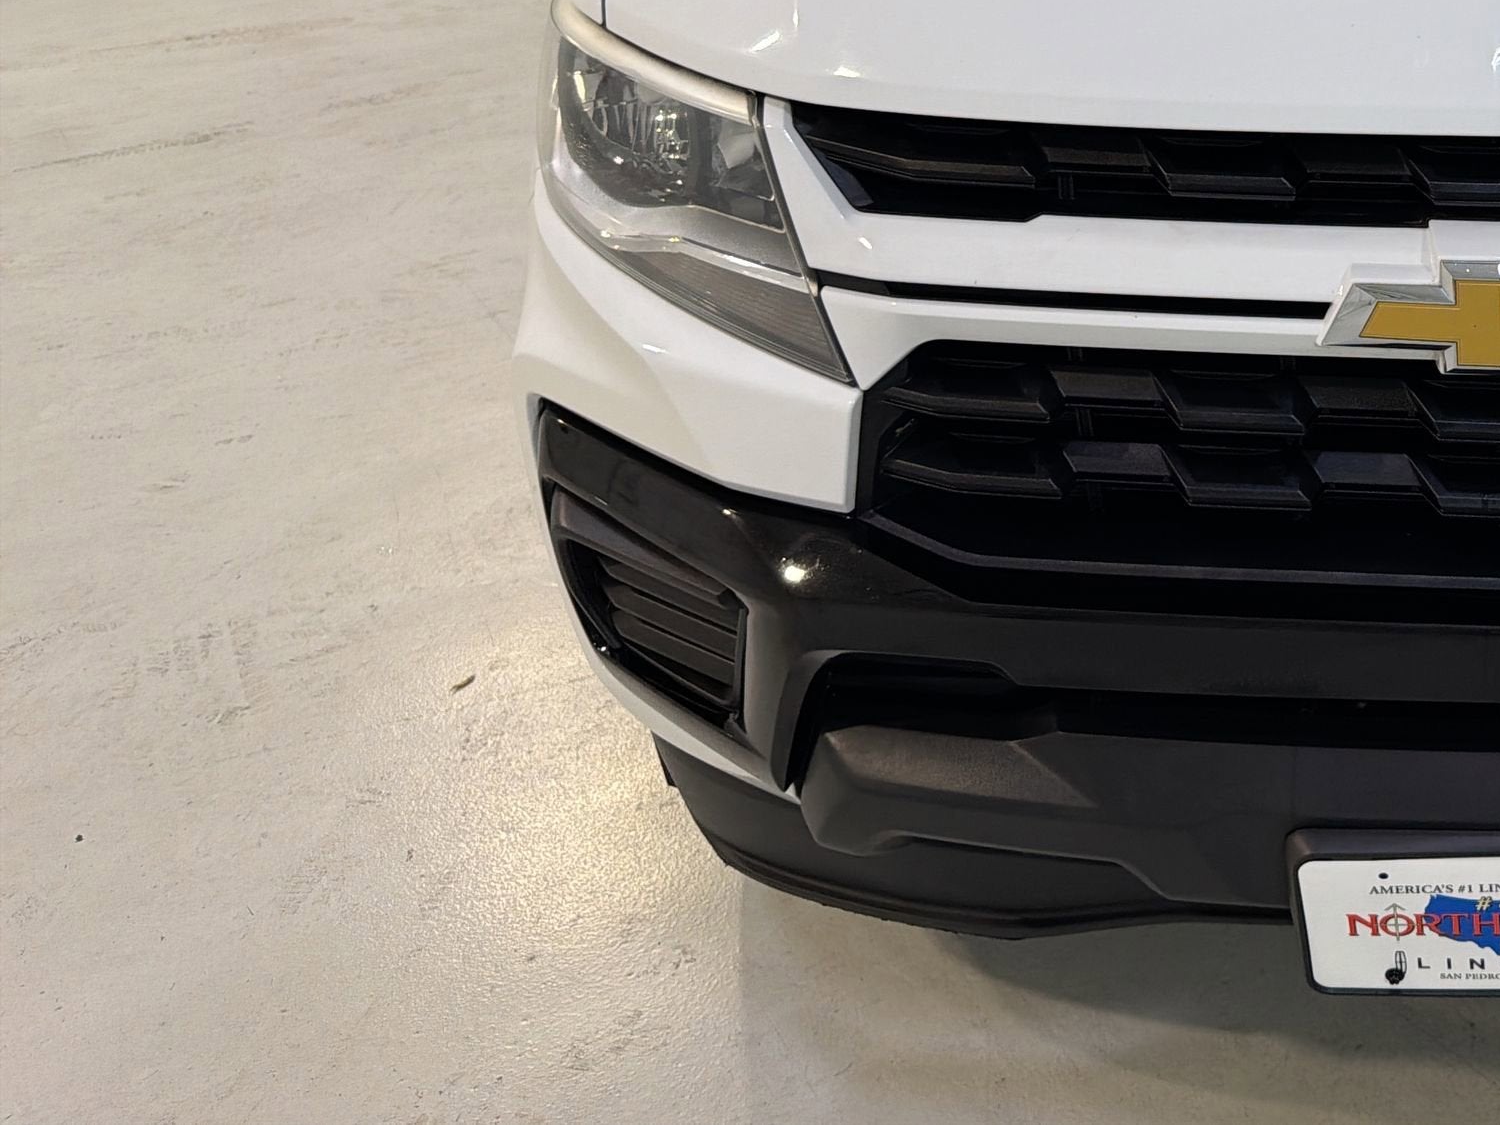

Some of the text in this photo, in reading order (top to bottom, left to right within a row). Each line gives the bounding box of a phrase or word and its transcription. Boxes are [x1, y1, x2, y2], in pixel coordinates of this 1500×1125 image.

[1369, 884, 1454, 895] AMERICA'S
[1457, 884, 1473, 894] #1
[1440, 972, 1461, 980] SAN
